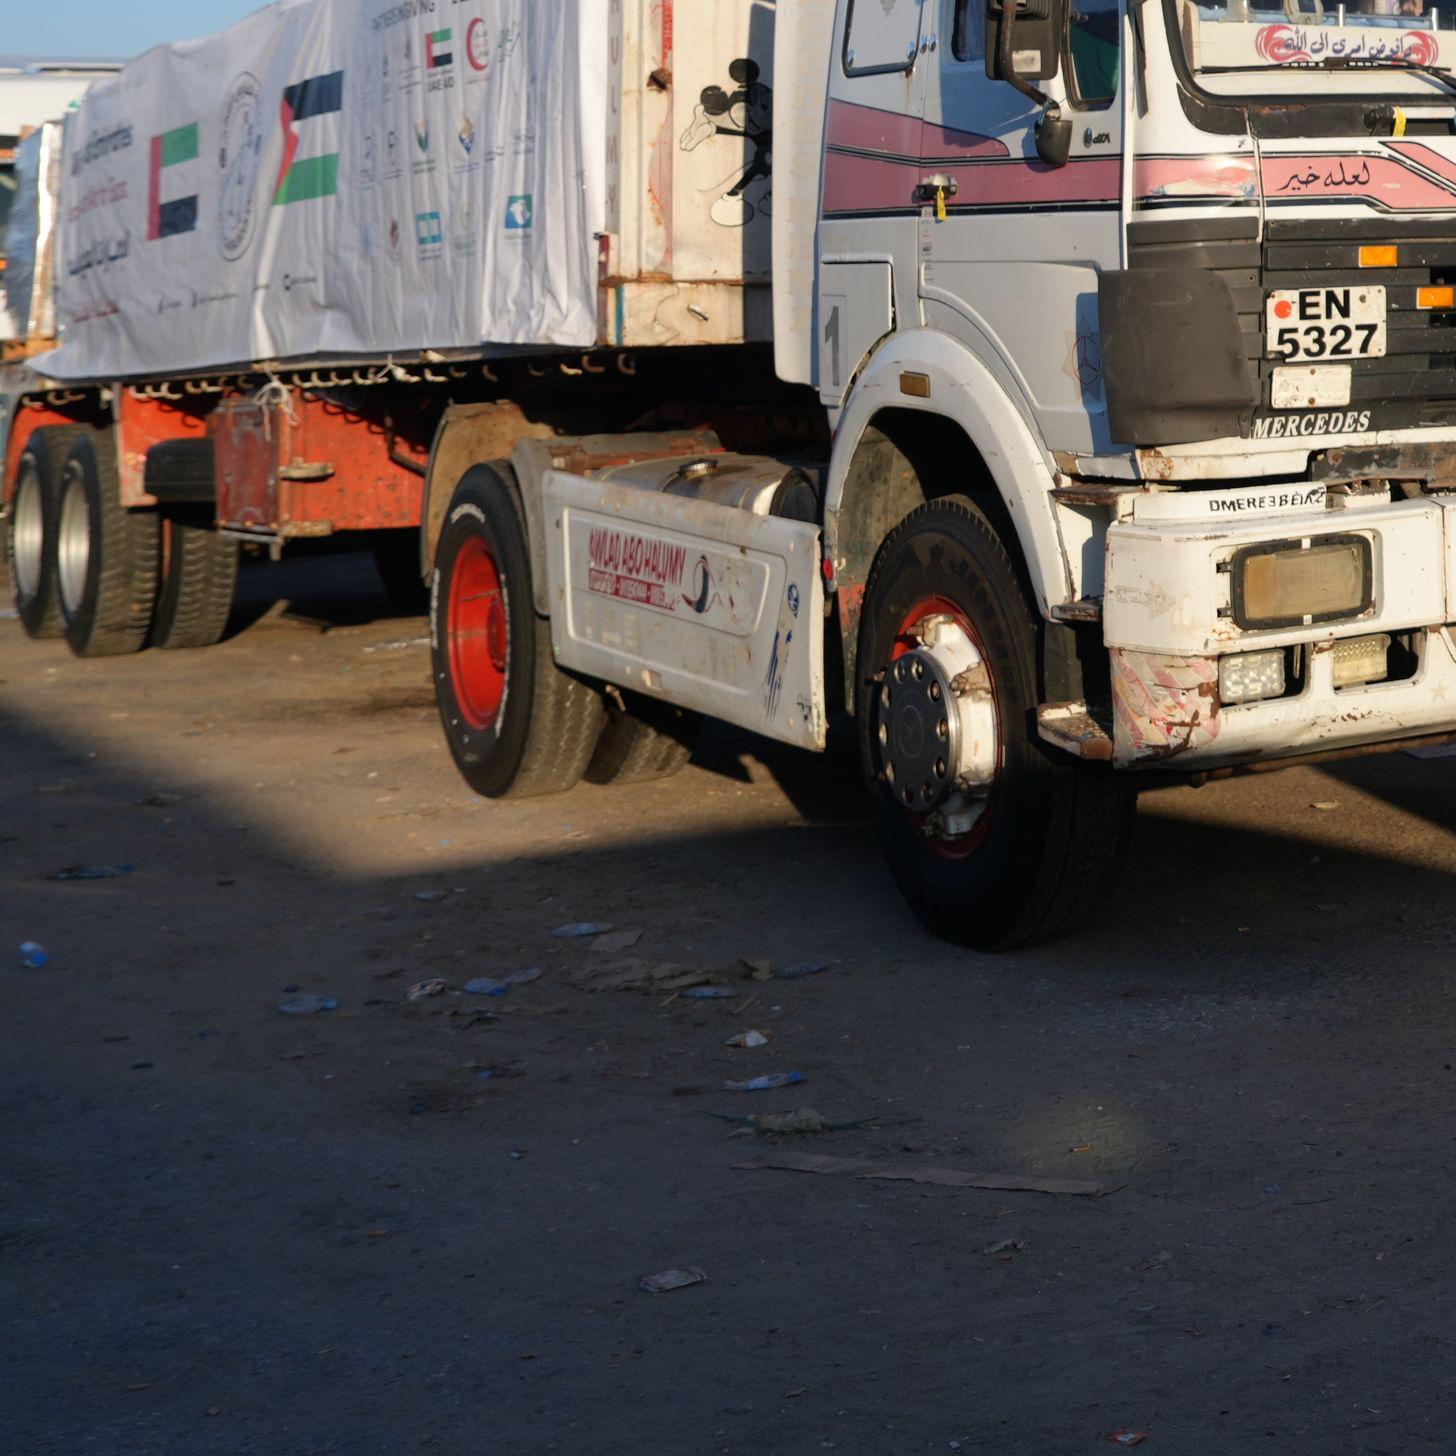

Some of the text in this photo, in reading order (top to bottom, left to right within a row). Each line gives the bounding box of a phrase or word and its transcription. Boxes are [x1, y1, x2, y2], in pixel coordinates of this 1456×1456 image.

[1275, 161, 1371, 192] لعله خير
[1299, 290, 1350, 320] EN
[1277, 324, 1378, 360] 5327
[1252, 410, 1371, 439] MERCEDES
